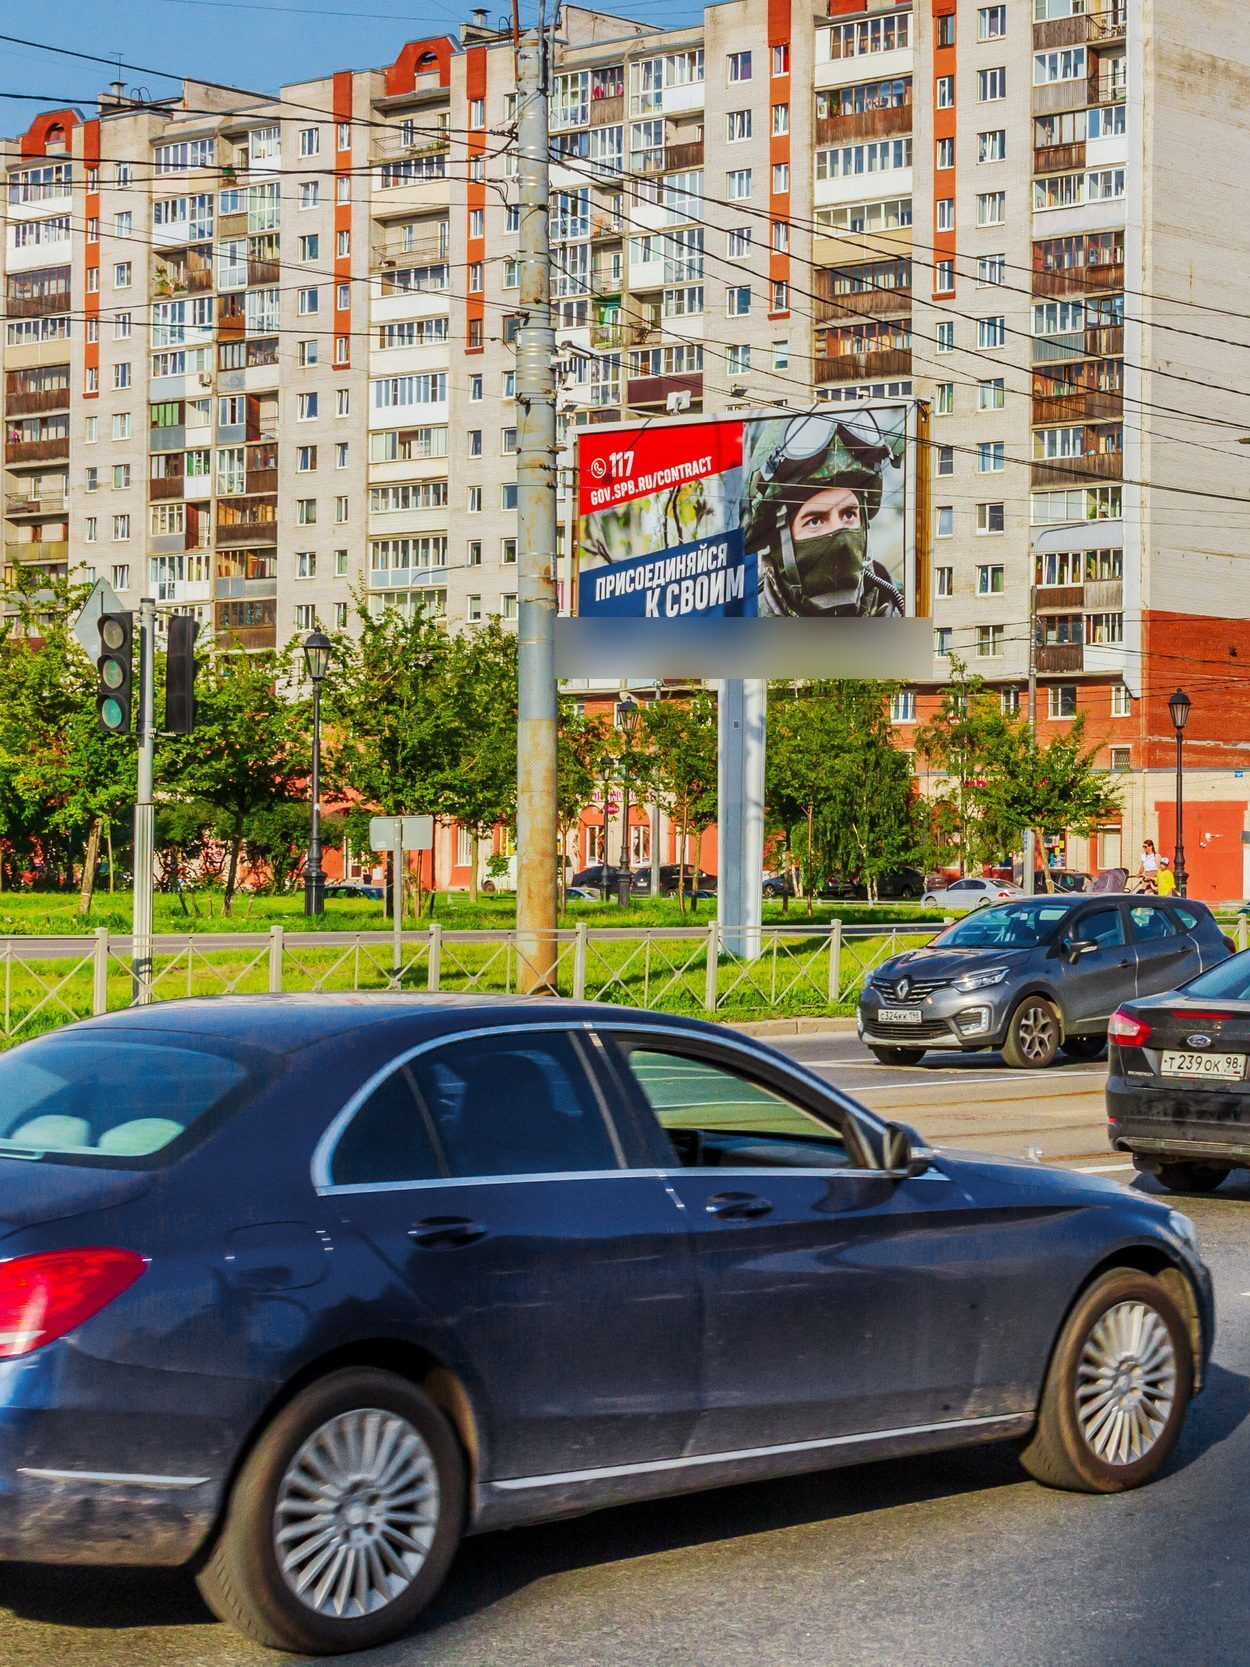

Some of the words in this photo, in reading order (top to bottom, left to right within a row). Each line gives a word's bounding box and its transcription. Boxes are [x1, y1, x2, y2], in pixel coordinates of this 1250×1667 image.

[590, 456, 713, 506] GOV.SPB.RU/CONTRACT
[609, 451, 634, 477] 117
[595, 543, 728, 602] ПРИСОЕДИНЯЙСЯ
[645, 588, 660, 617] К
[665, 564, 745, 617] СВОИМ
[1225, 1057, 1238, 1068] 98
